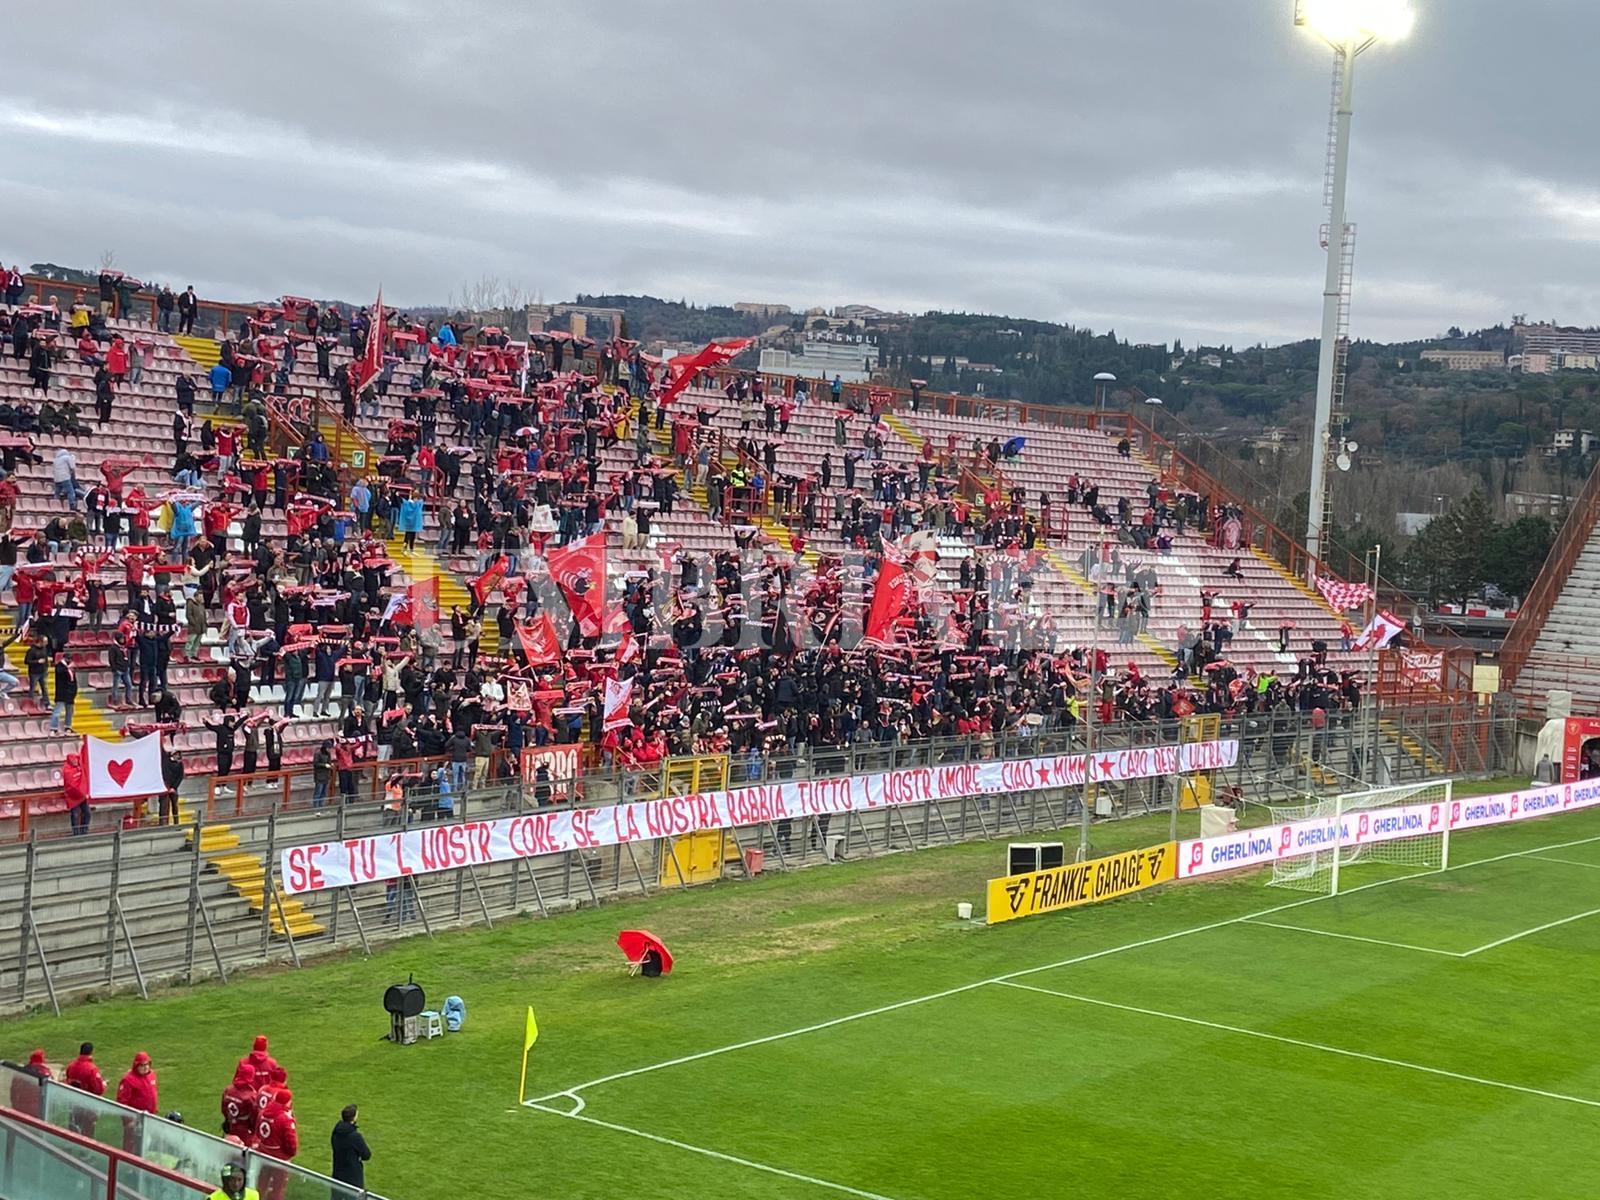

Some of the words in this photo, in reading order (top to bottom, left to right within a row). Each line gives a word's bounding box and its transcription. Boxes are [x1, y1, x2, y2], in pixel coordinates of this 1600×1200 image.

[345, 839, 376, 882] TU
[614, 804, 641, 842] LA
[646, 794, 723, 838] NOSTRA
[798, 778, 852, 814] TUTTO
[1002, 760, 1035, 790] CIAO
[1119, 750, 1148, 778] CAPO
[1211, 834, 1273, 864] GHERLINDA
[1373, 809, 1423, 835] GHERLINDA
[1030, 865, 1092, 911] FRANKIE
[1094, 853, 1145, 898] GARAGE
